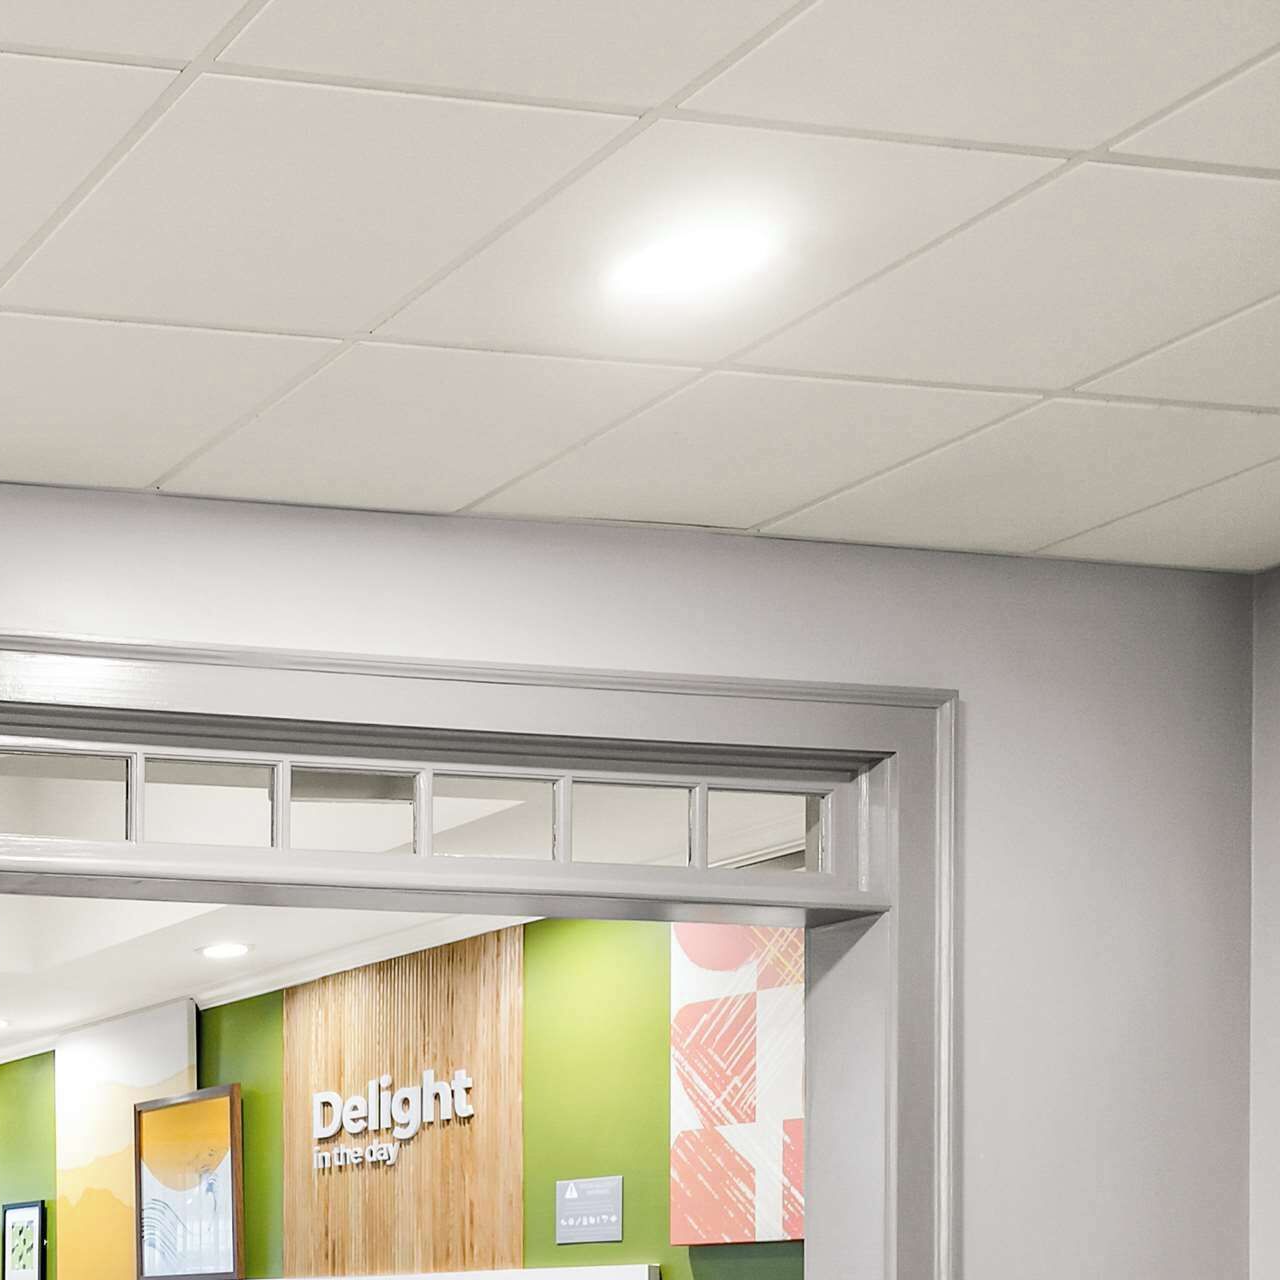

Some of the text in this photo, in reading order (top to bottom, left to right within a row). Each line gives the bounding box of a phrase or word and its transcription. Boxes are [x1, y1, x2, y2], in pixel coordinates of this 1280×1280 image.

[312, 1069, 475, 1141] Delight
[313, 1140, 400, 1169] in the day
